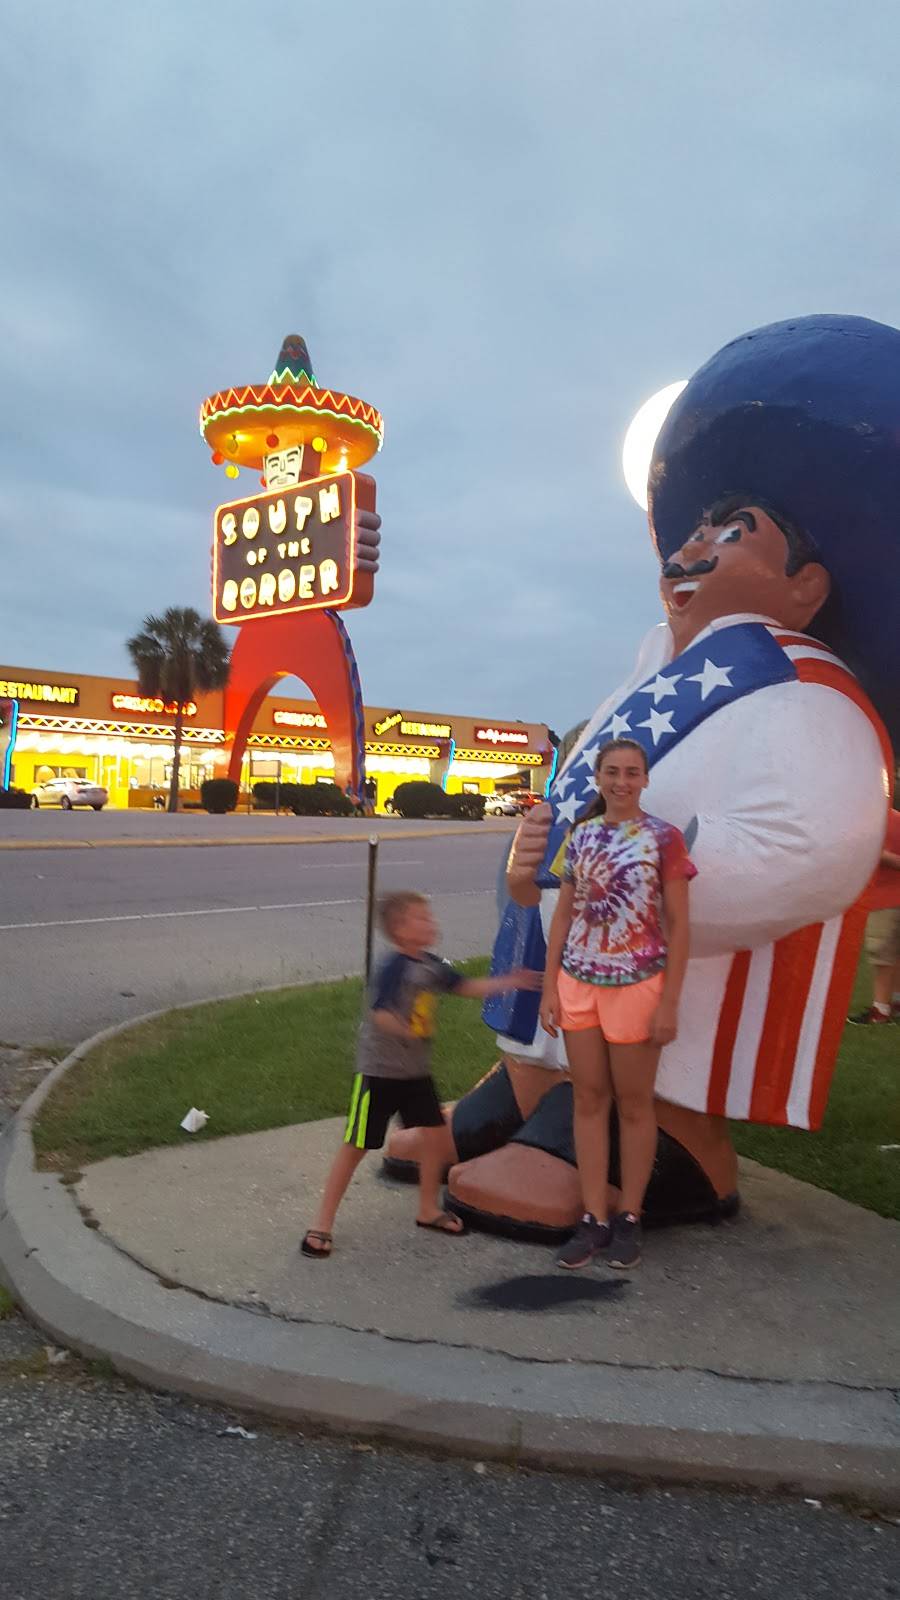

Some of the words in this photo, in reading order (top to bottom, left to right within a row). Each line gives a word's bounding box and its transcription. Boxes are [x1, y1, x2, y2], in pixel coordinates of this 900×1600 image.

[221, 483, 340, 546] SOUTH
[246, 547, 267, 565] OF
[277, 537, 310, 559] THE
[221, 558, 339, 612] BORDER
